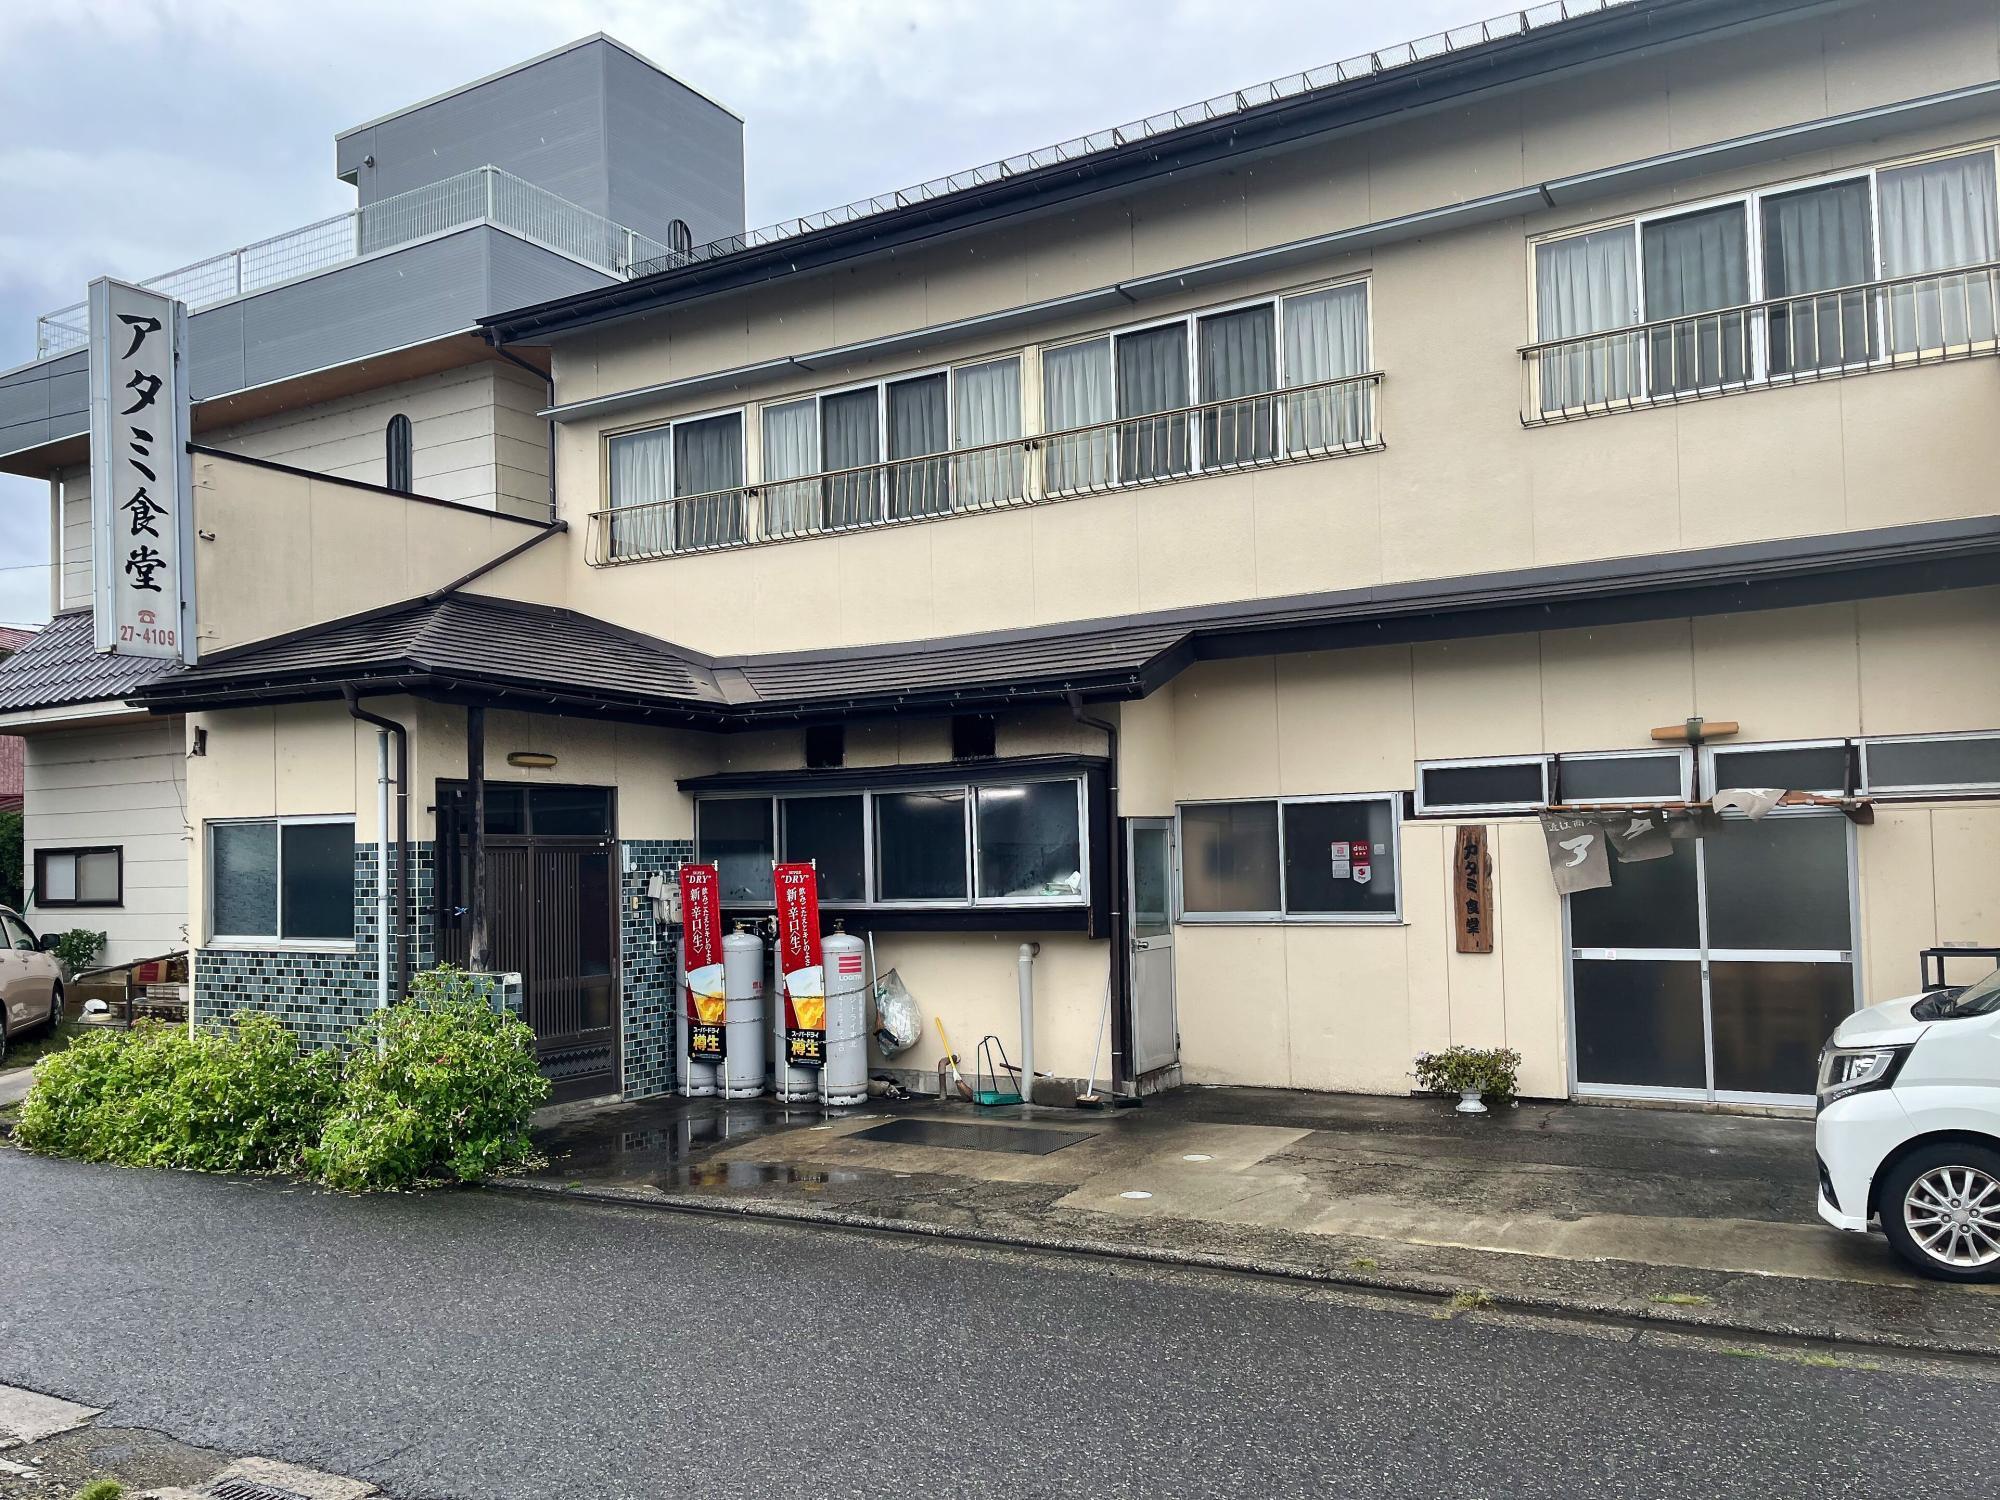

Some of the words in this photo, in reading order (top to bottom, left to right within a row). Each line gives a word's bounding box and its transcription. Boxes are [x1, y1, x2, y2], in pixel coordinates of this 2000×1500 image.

[116, 312, 169, 593] アタミ食堂
[119, 624, 176, 647] 27-4109
[693, 1026, 720, 1034] スーパードライ
[791, 1030, 819, 1038] スーパードライ
[692, 1033, 721, 1052] 樽生
[791, 1037, 820, 1057] 樽生
